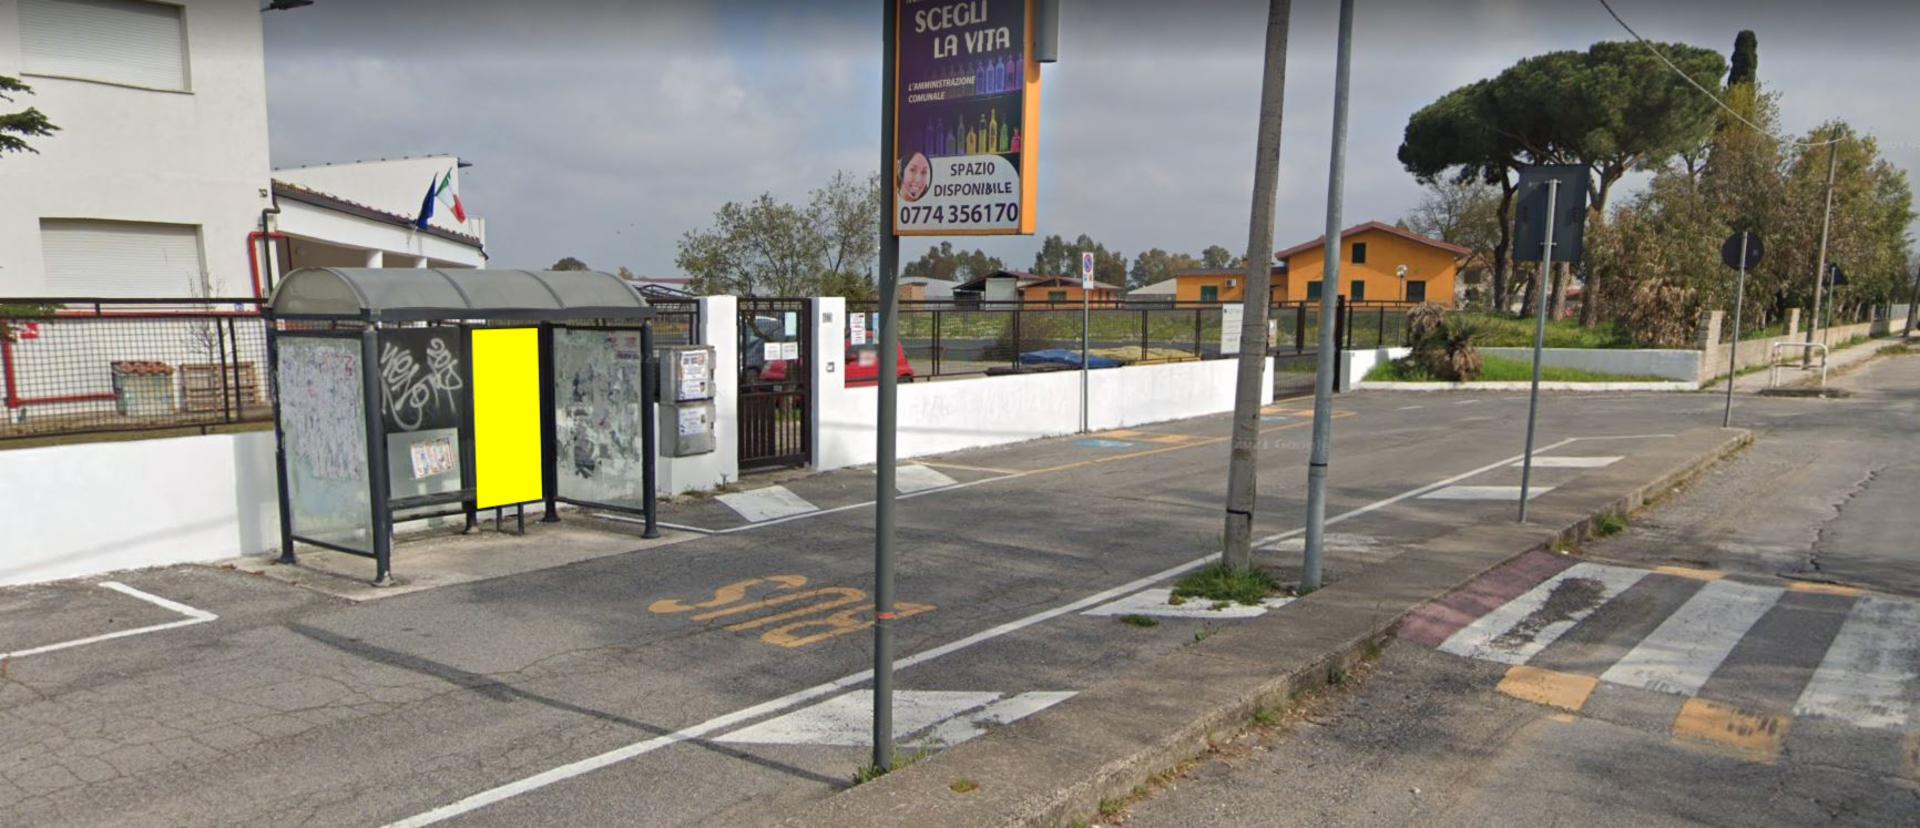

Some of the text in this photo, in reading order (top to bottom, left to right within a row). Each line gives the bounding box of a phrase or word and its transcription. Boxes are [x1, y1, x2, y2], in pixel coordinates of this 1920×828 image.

[915, 0, 988, 33] SCEGLI
[933, 26, 1010, 59] LA VITA
[908, 75, 976, 92] L'AMMINISTRAZIONE
[908, 91, 945, 103] COMUNALE
[950, 162, 995, 177] SPAZIO
[933, 182, 1013, 197] DISPONIBILE
[900, 203, 1018, 225] 0774 356170
[649, 575, 938, 648] BUS
